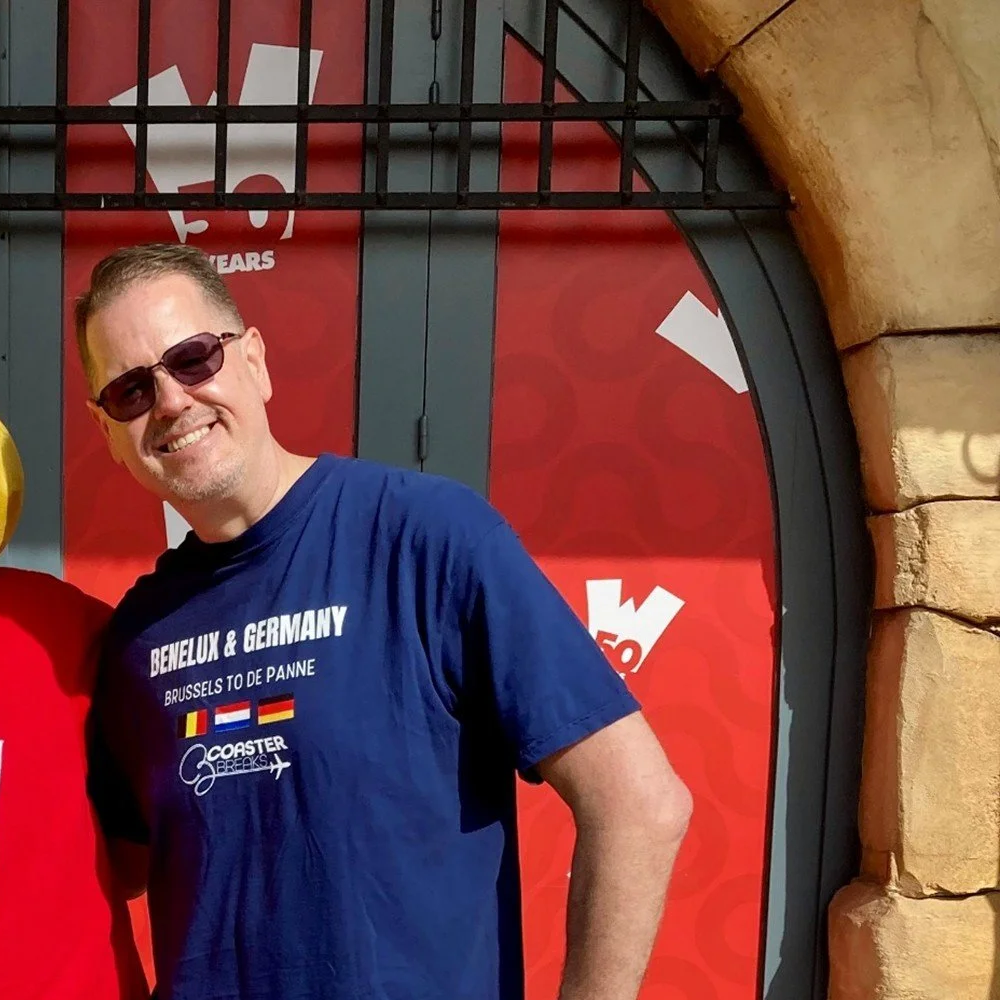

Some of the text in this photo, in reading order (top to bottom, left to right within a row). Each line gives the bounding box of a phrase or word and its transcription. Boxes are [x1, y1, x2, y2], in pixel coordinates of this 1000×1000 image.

[150, 605, 348, 678] BENELUX & GERMANY
[164, 658, 316, 707] BRUSSELS TO DE PANNE
[207, 735, 288, 762] COASTER
[216, 753, 269, 774] BREAKS
